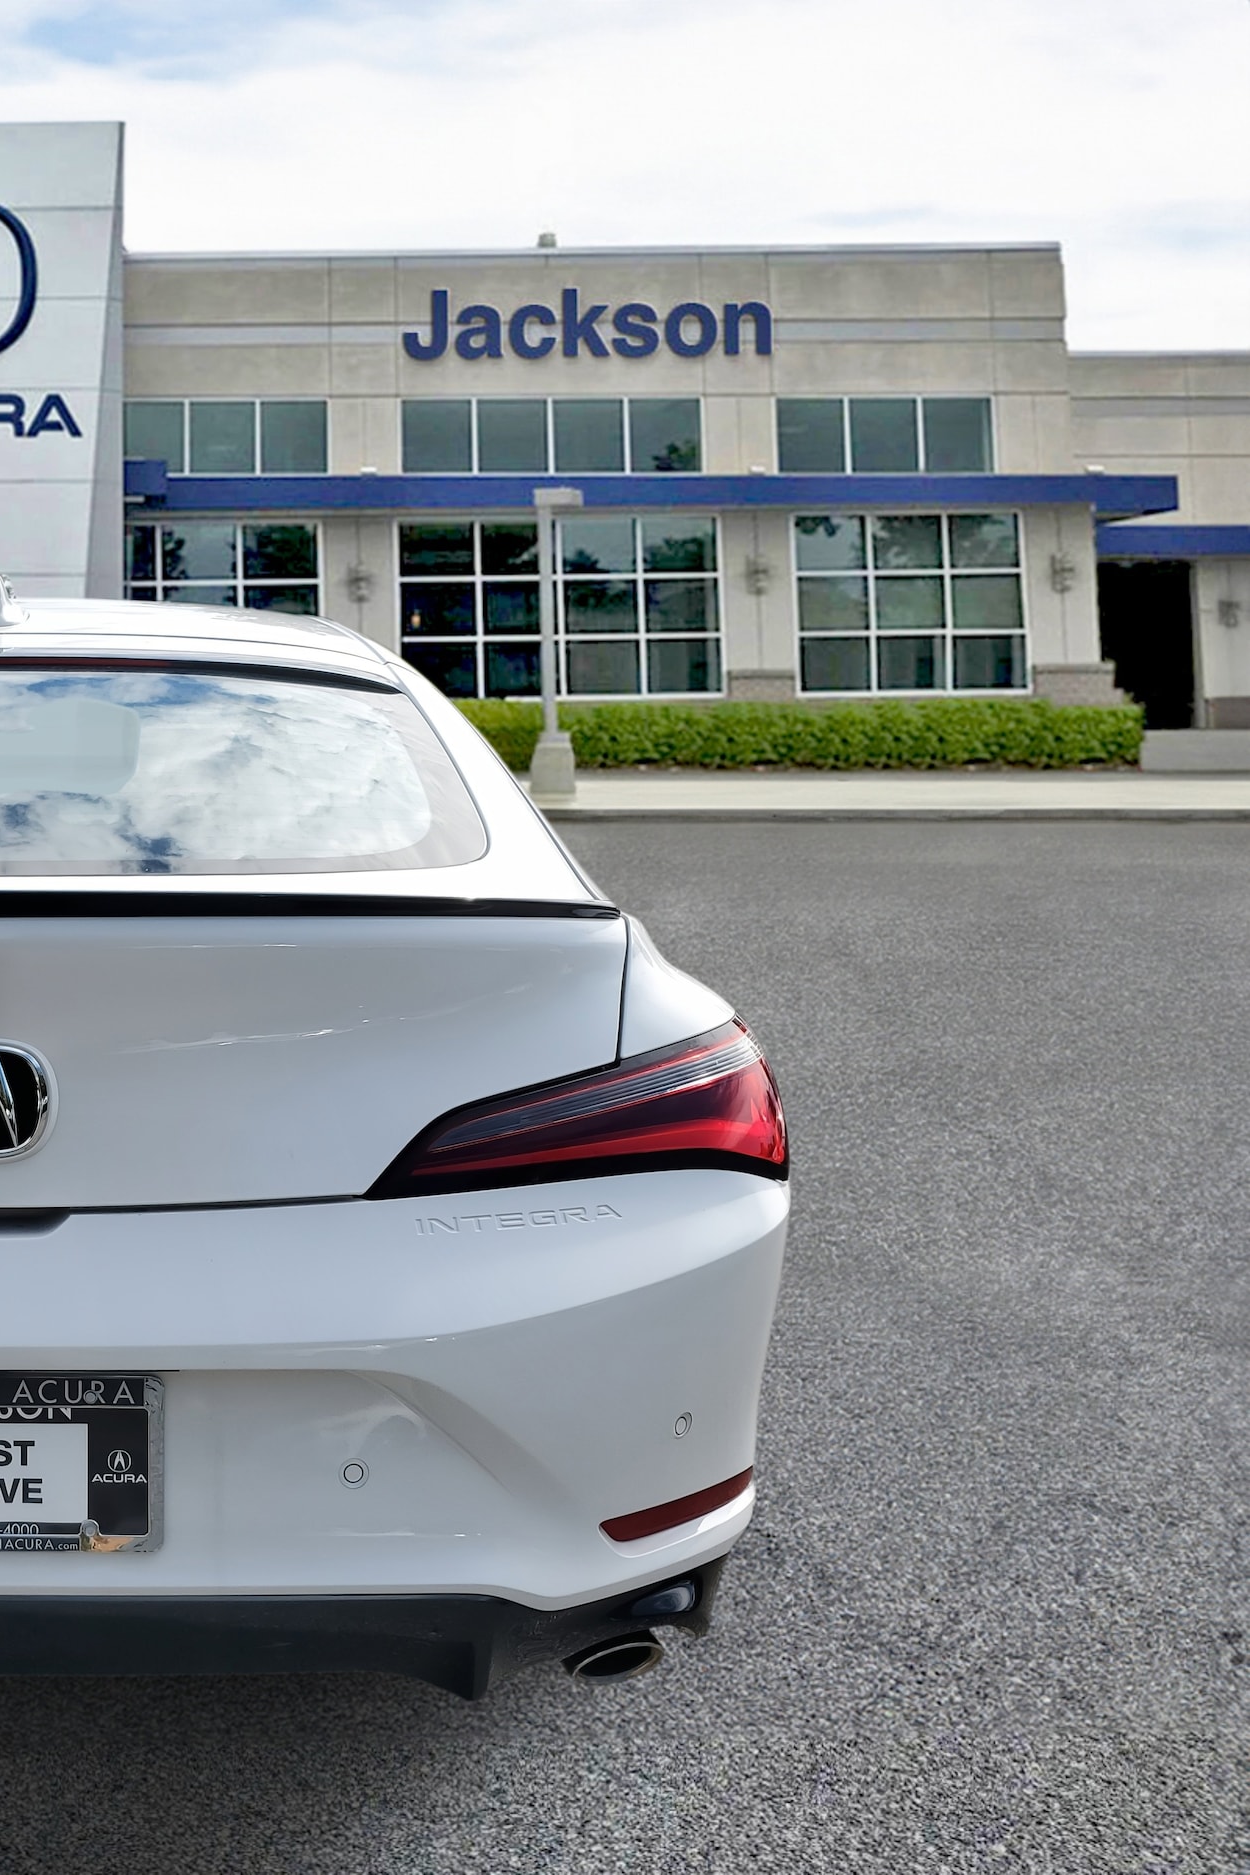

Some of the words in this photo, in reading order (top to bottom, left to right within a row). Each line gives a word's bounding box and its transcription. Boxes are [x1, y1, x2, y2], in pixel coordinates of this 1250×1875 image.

[402, 288, 772, 361] Jackson
[414, 1204, 623, 1236] INTEGRA
[12, 1379, 135, 1404] ACURA
[91, 1473, 147, 1484] ACURA
